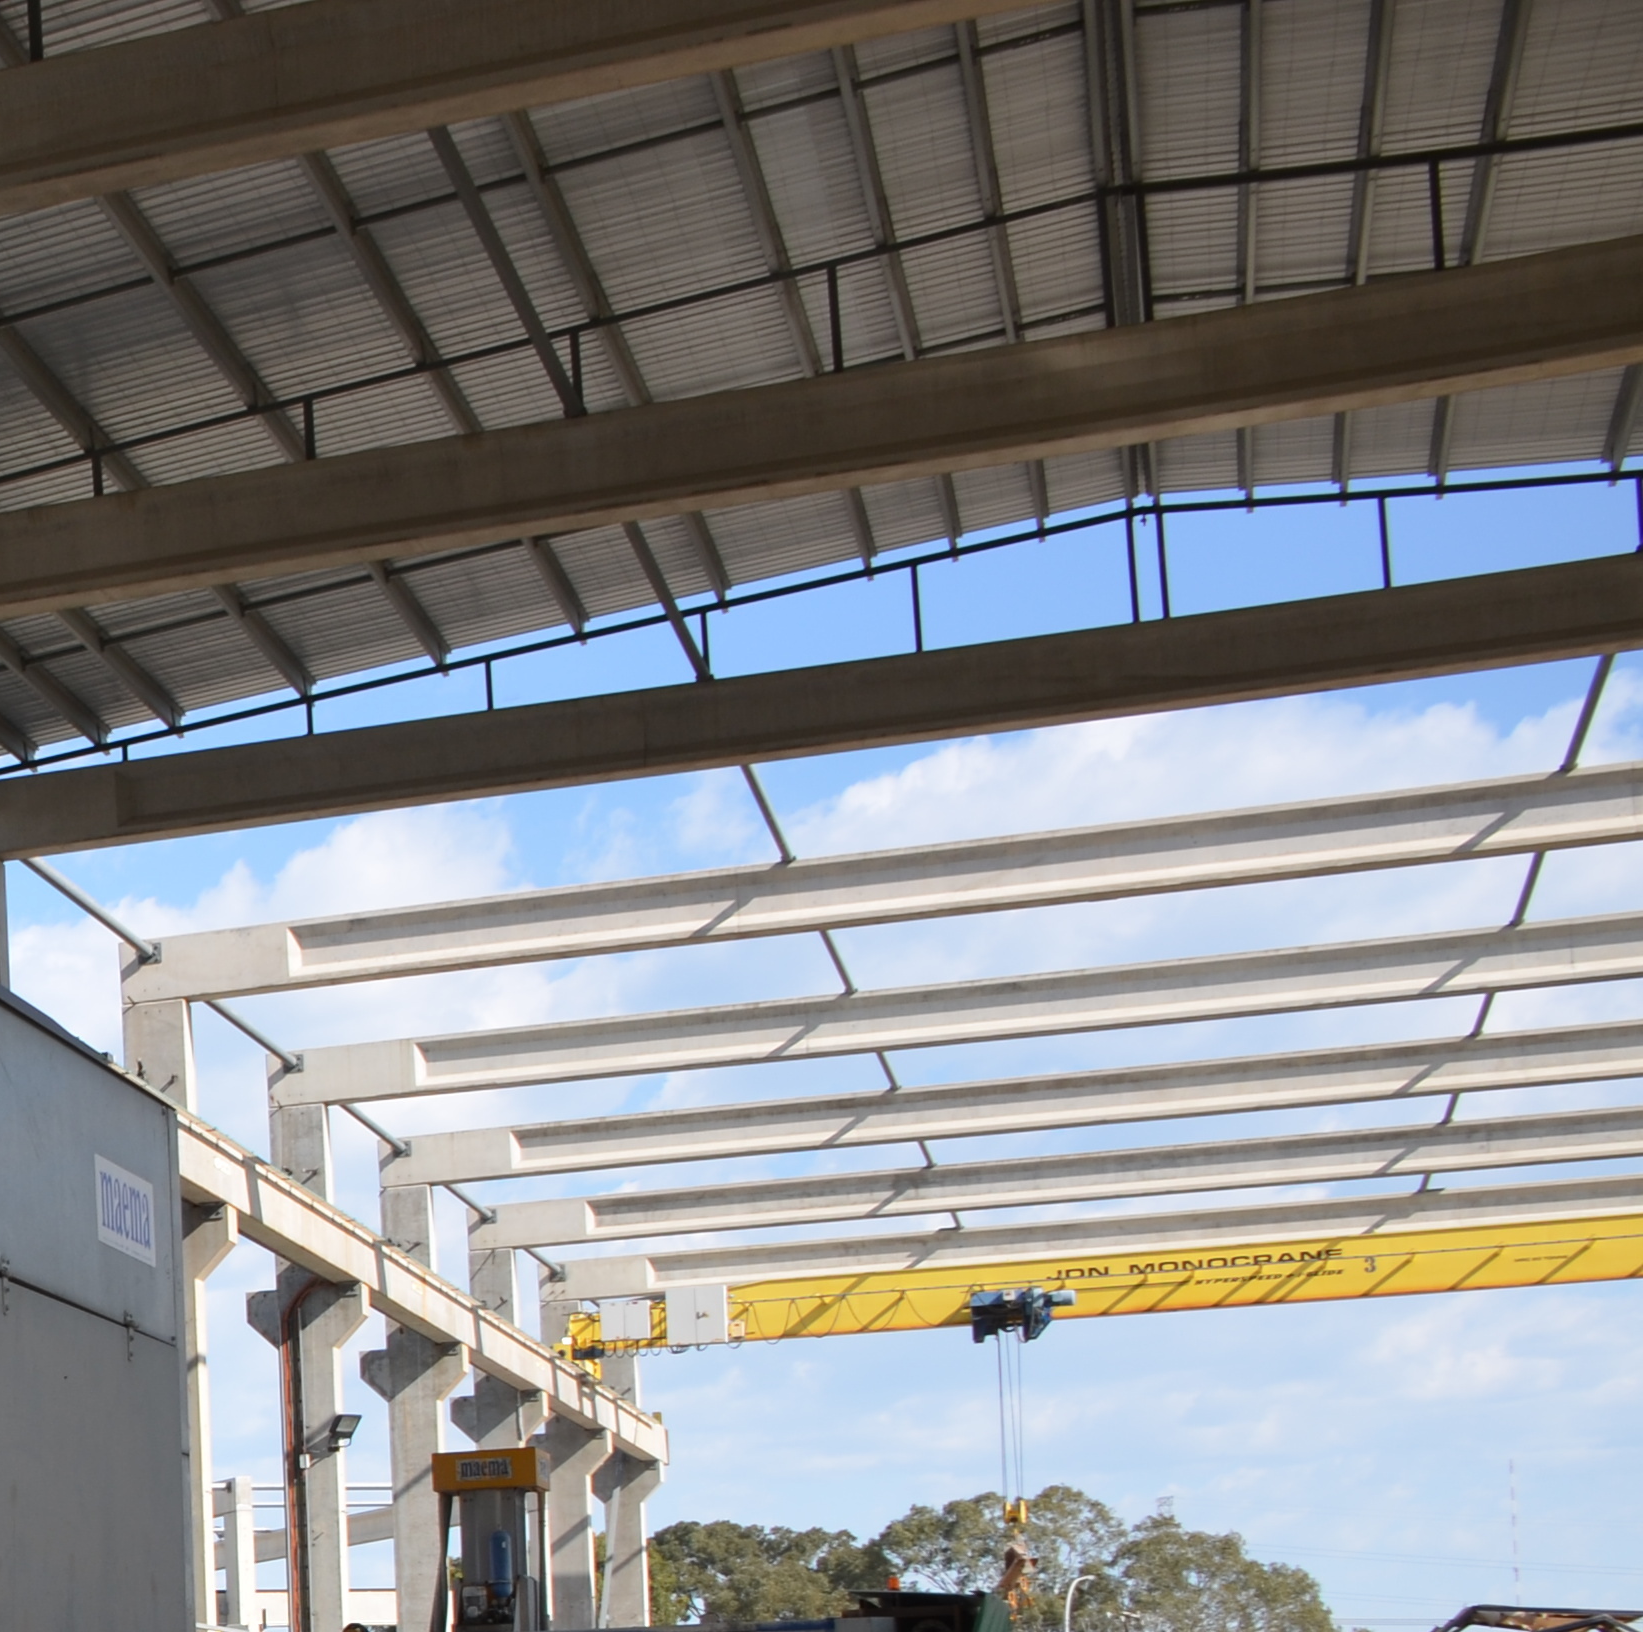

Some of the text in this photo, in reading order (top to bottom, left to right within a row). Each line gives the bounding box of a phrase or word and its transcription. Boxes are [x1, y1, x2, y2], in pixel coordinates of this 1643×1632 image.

[99, 1171, 151, 1250] maema
[1046, 1248, 1342, 1281] JDN MONOCRANE
[1364, 1257, 1376, 1273] 3
[460, 1459, 509, 1478] maema
